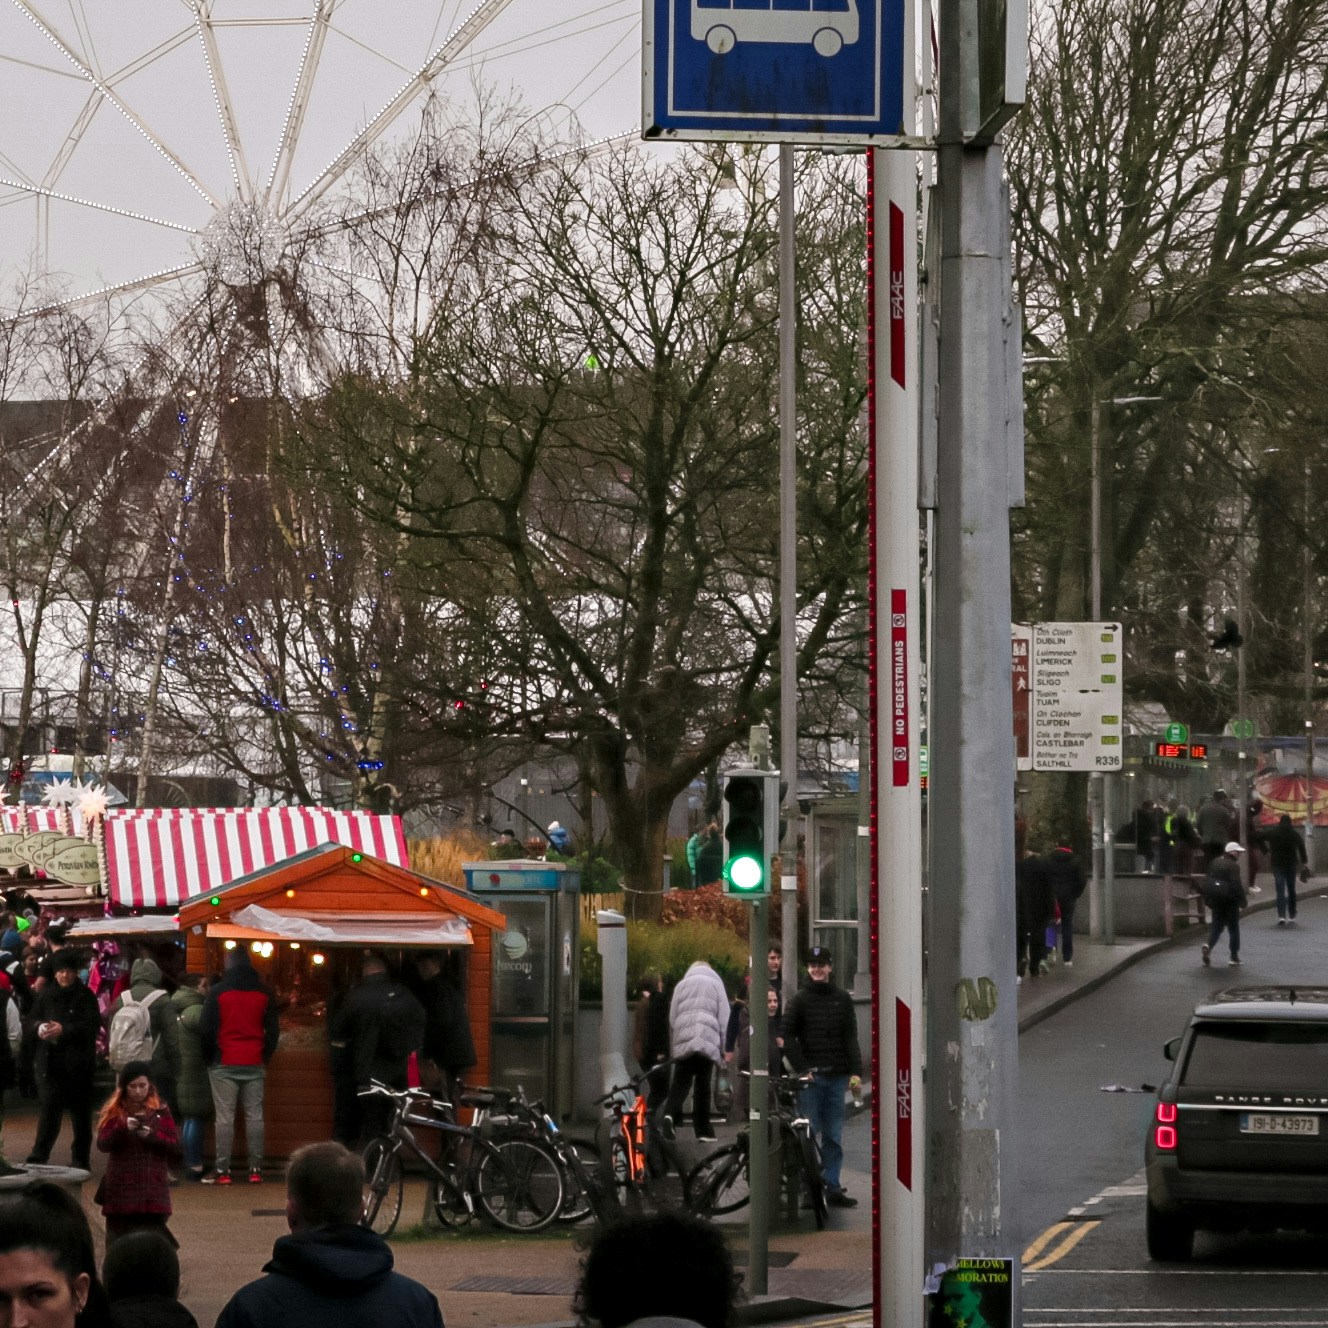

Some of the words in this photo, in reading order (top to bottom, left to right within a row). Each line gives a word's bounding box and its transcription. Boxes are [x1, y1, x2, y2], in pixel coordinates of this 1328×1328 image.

[1036, 658, 1073, 666] LIMERICK
[895, 640, 905, 716] PEDESTRIANS
[1037, 690, 1058, 698] Tuaim
[896, 718, 905, 735] NO
[1095, 756, 1120, 766] R336
[898, 1069, 910, 1118] FAAC
[1215, 1095, 1272, 1104] RANGE
[1253, 1116, 1314, 1131] 191-D-43973
